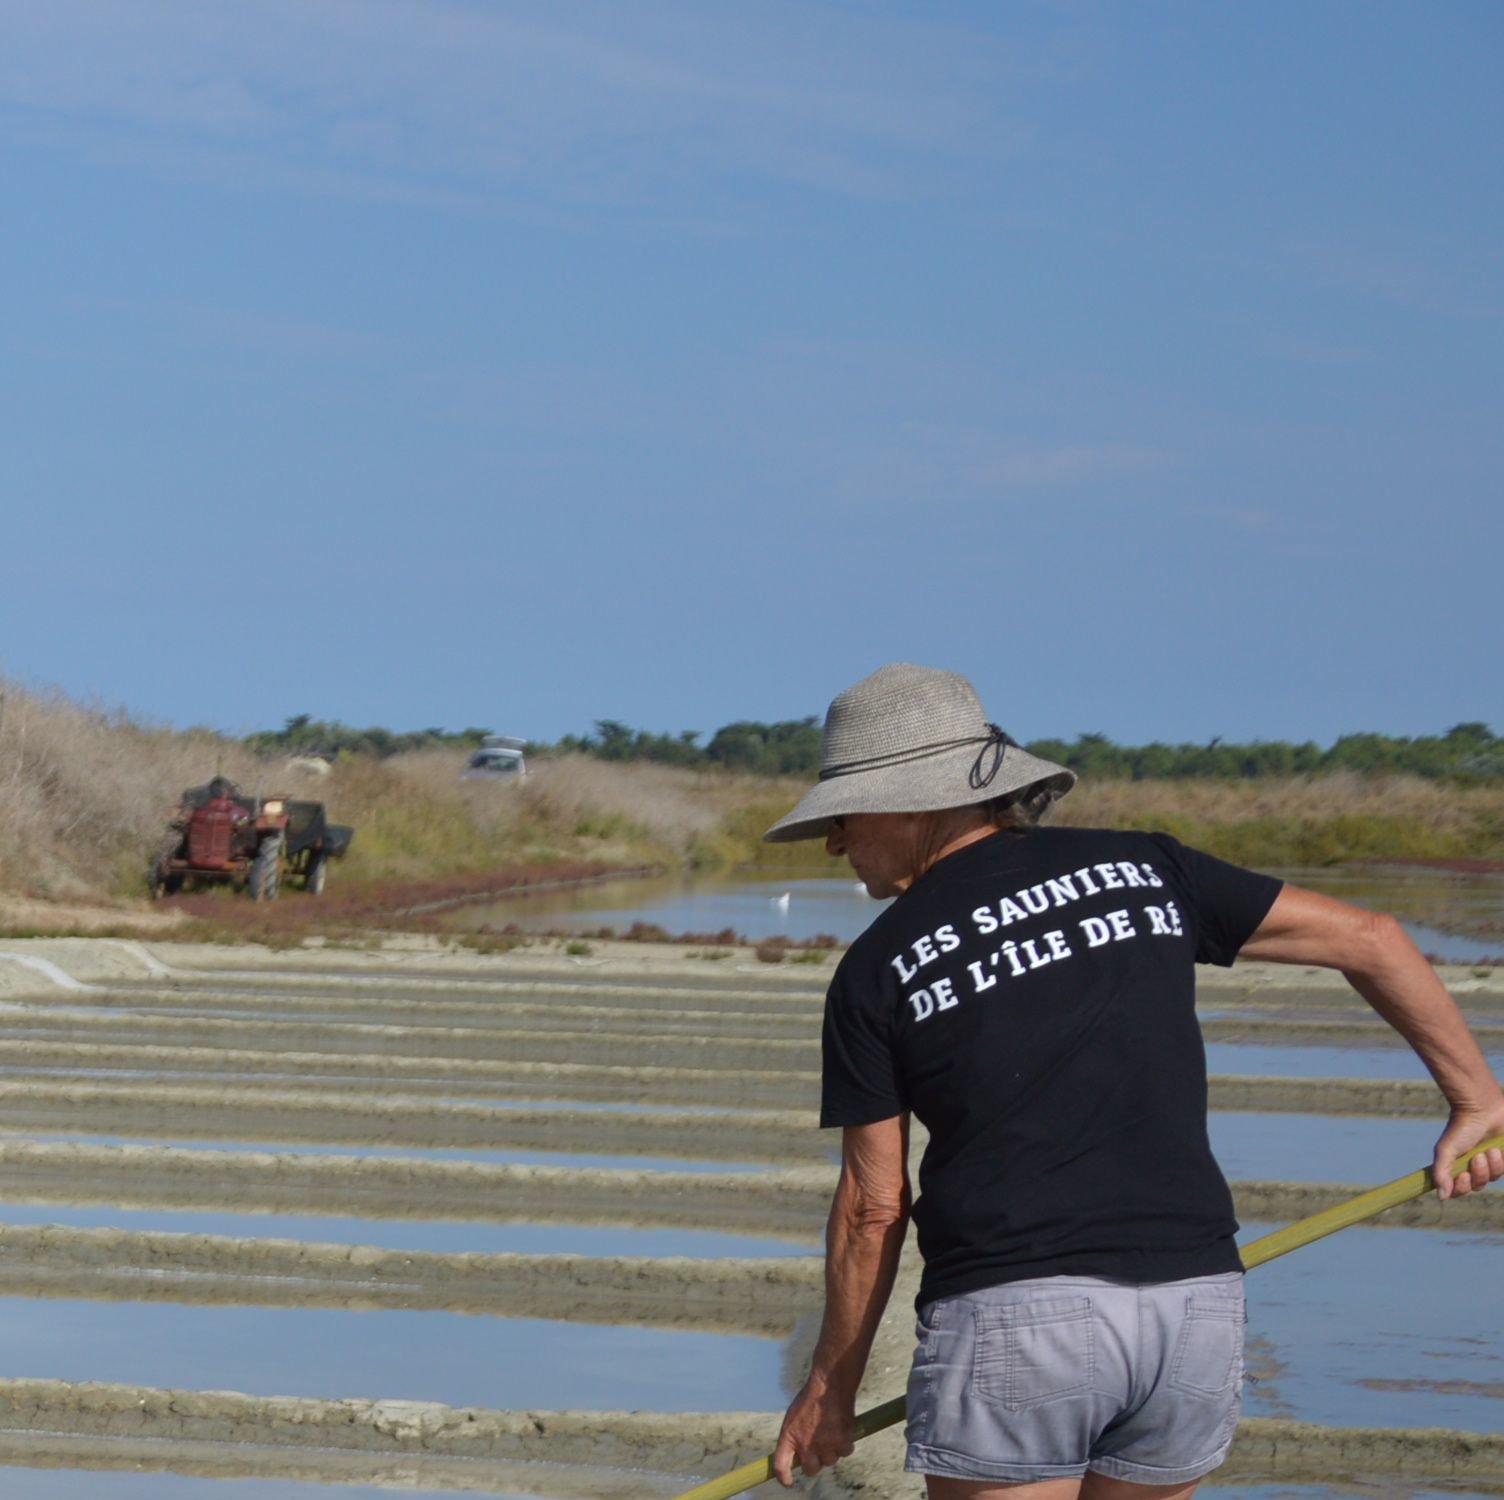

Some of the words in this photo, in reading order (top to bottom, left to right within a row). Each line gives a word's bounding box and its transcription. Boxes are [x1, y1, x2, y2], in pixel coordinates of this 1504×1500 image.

[890, 924, 961, 984] LES
[971, 861, 1164, 935] SAUNIERS
[908, 977, 959, 1022] DE
[966, 929, 1073, 993] L'ÎLE
[1078, 908, 1137, 948] DE
[1143, 900, 1183, 937] RÉ
